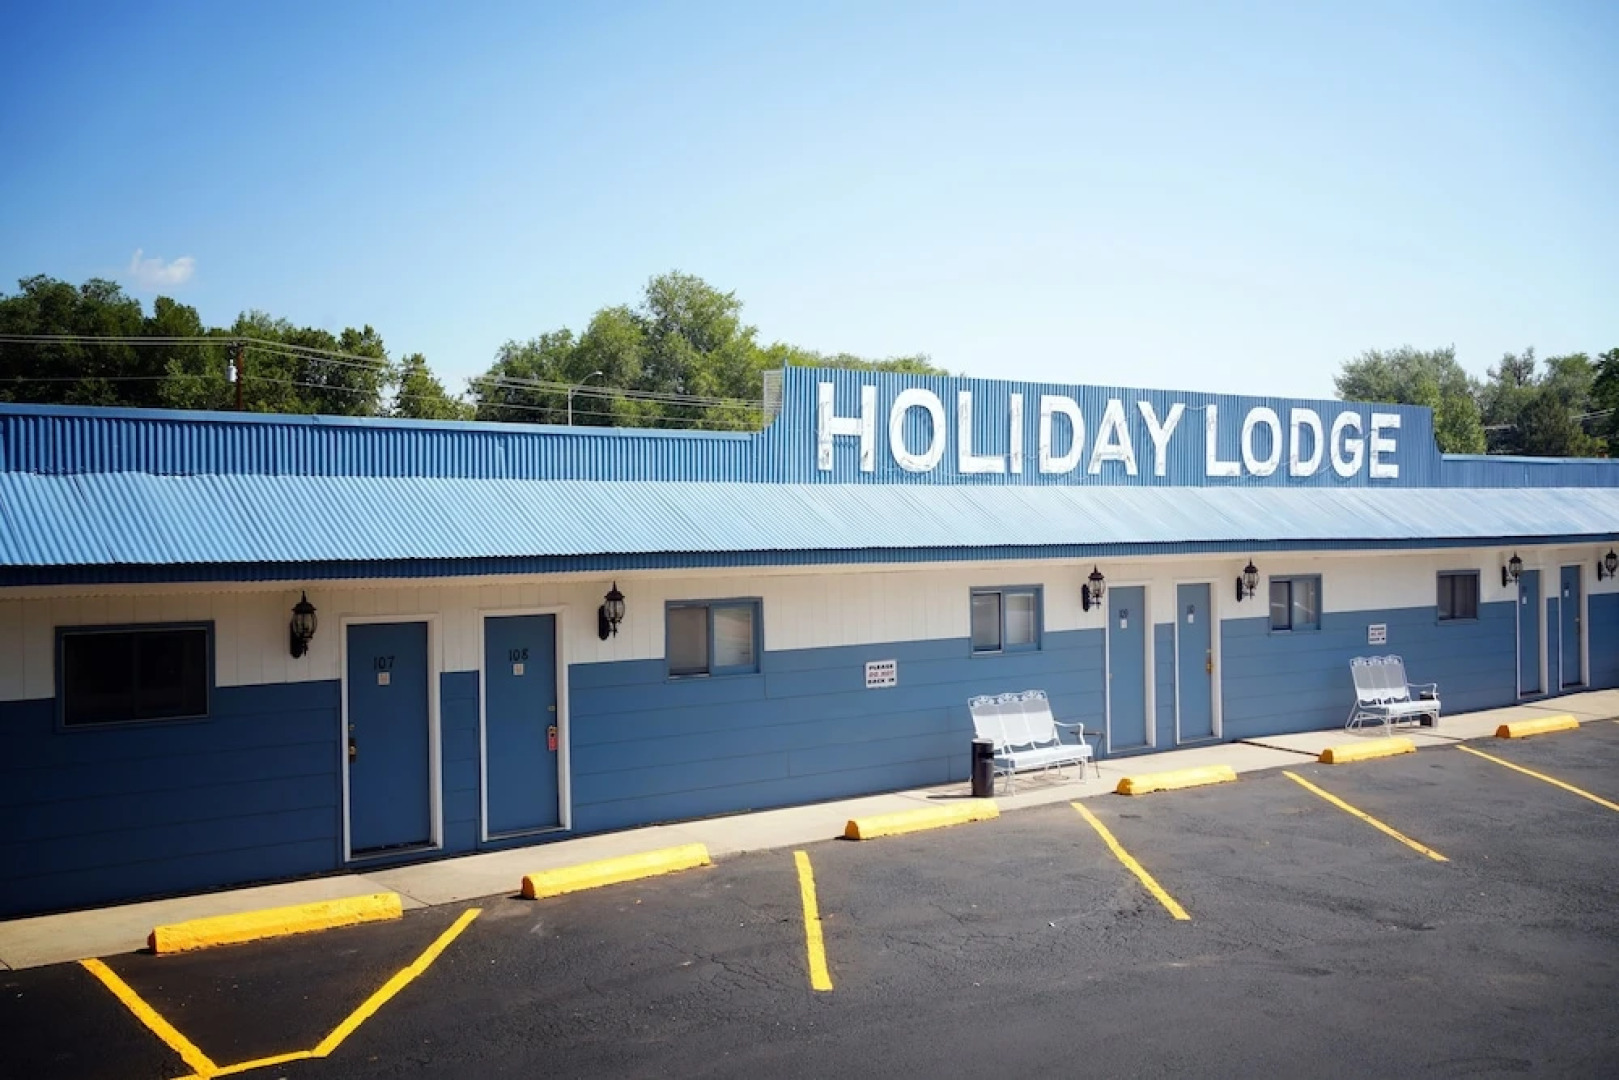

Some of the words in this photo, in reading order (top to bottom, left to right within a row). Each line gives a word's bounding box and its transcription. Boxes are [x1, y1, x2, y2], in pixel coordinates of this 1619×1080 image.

[817, 381, 1186, 477] HOLIDAY
[1204, 404, 1401, 479] LODGE
[509, 648, 529, 661] 108
[374, 656, 395, 670] 107
